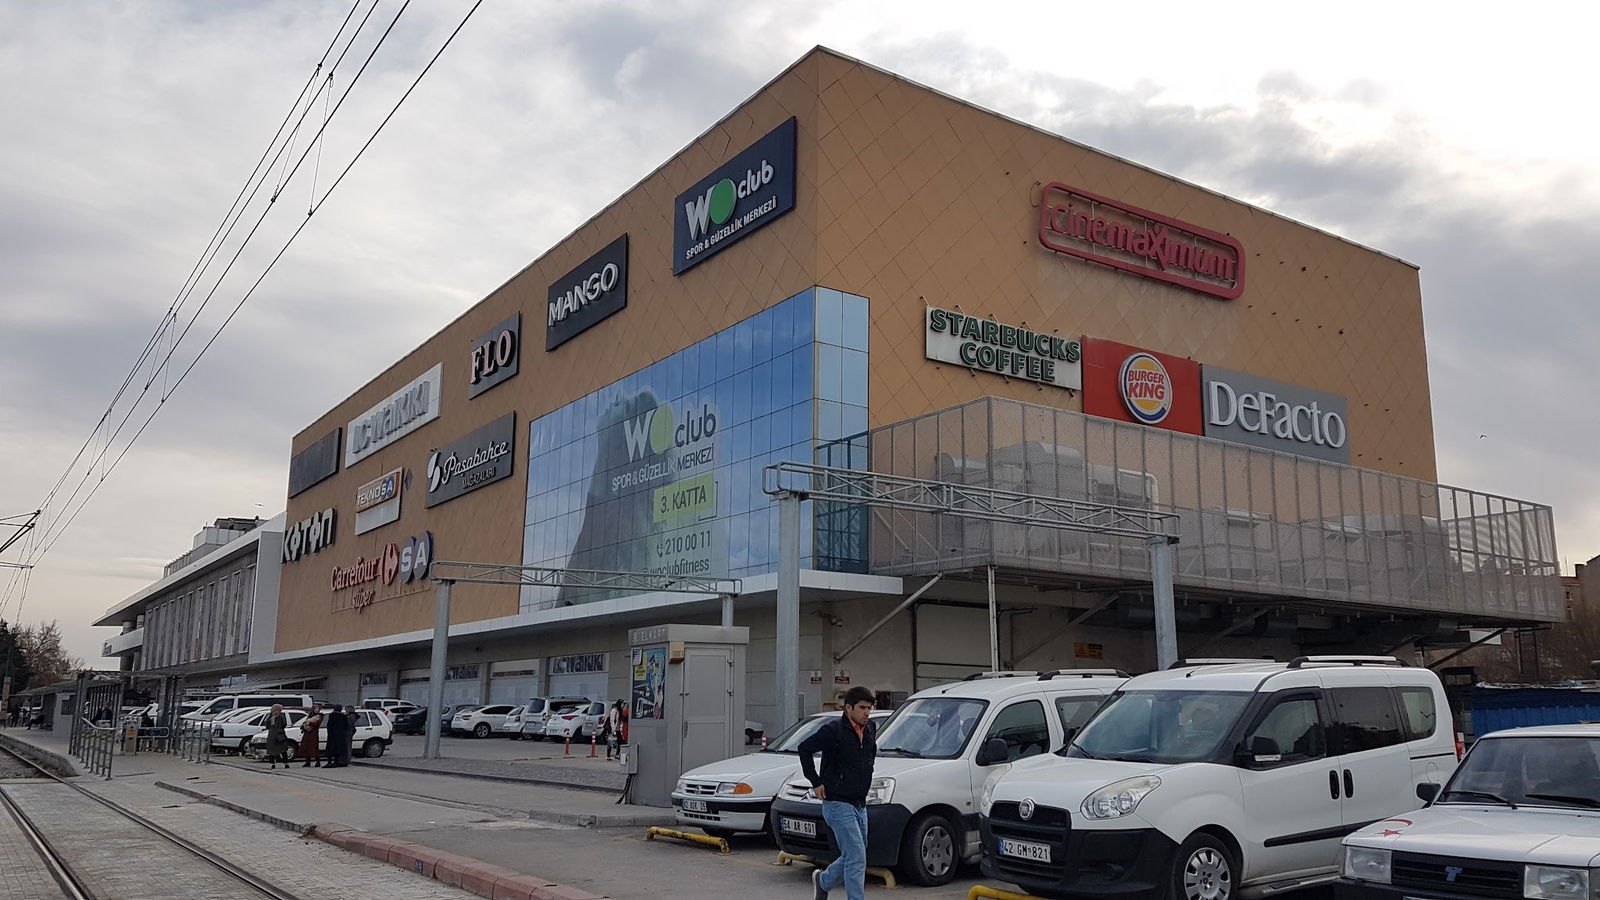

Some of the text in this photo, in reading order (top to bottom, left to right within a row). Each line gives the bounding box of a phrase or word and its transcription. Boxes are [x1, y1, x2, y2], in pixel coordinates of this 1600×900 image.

[686, 241, 705, 260] SPOR
[710, 218, 744, 246] GÜZELLİK
[743, 195, 777, 227] MERKEZİ
[548, 263, 619, 327] MANGO
[931, 309, 1080, 362] STARBUCKS
[470, 330, 515, 384] FLO
[960, 342, 1055, 382] COFFEE
[1128, 370, 1164, 385] BURGER
[1128, 383, 1165, 400] KING
[1209, 381, 1346, 449] DeFacto
[441, 441, 508, 485] Paşabahçe
[612, 472, 632, 491] SPOR
[638, 457, 676, 482] GÜZELLİK
[677, 443, 715, 471] MERKEZİ
[357, 479, 393, 507] TEKNOSA
[661, 484, 707, 514] 3. KATTA
[665, 530, 711, 556] 210 00 11
[331, 556, 381, 591] Carrefour
[1004, 841, 1048, 860] 42 GM 821
